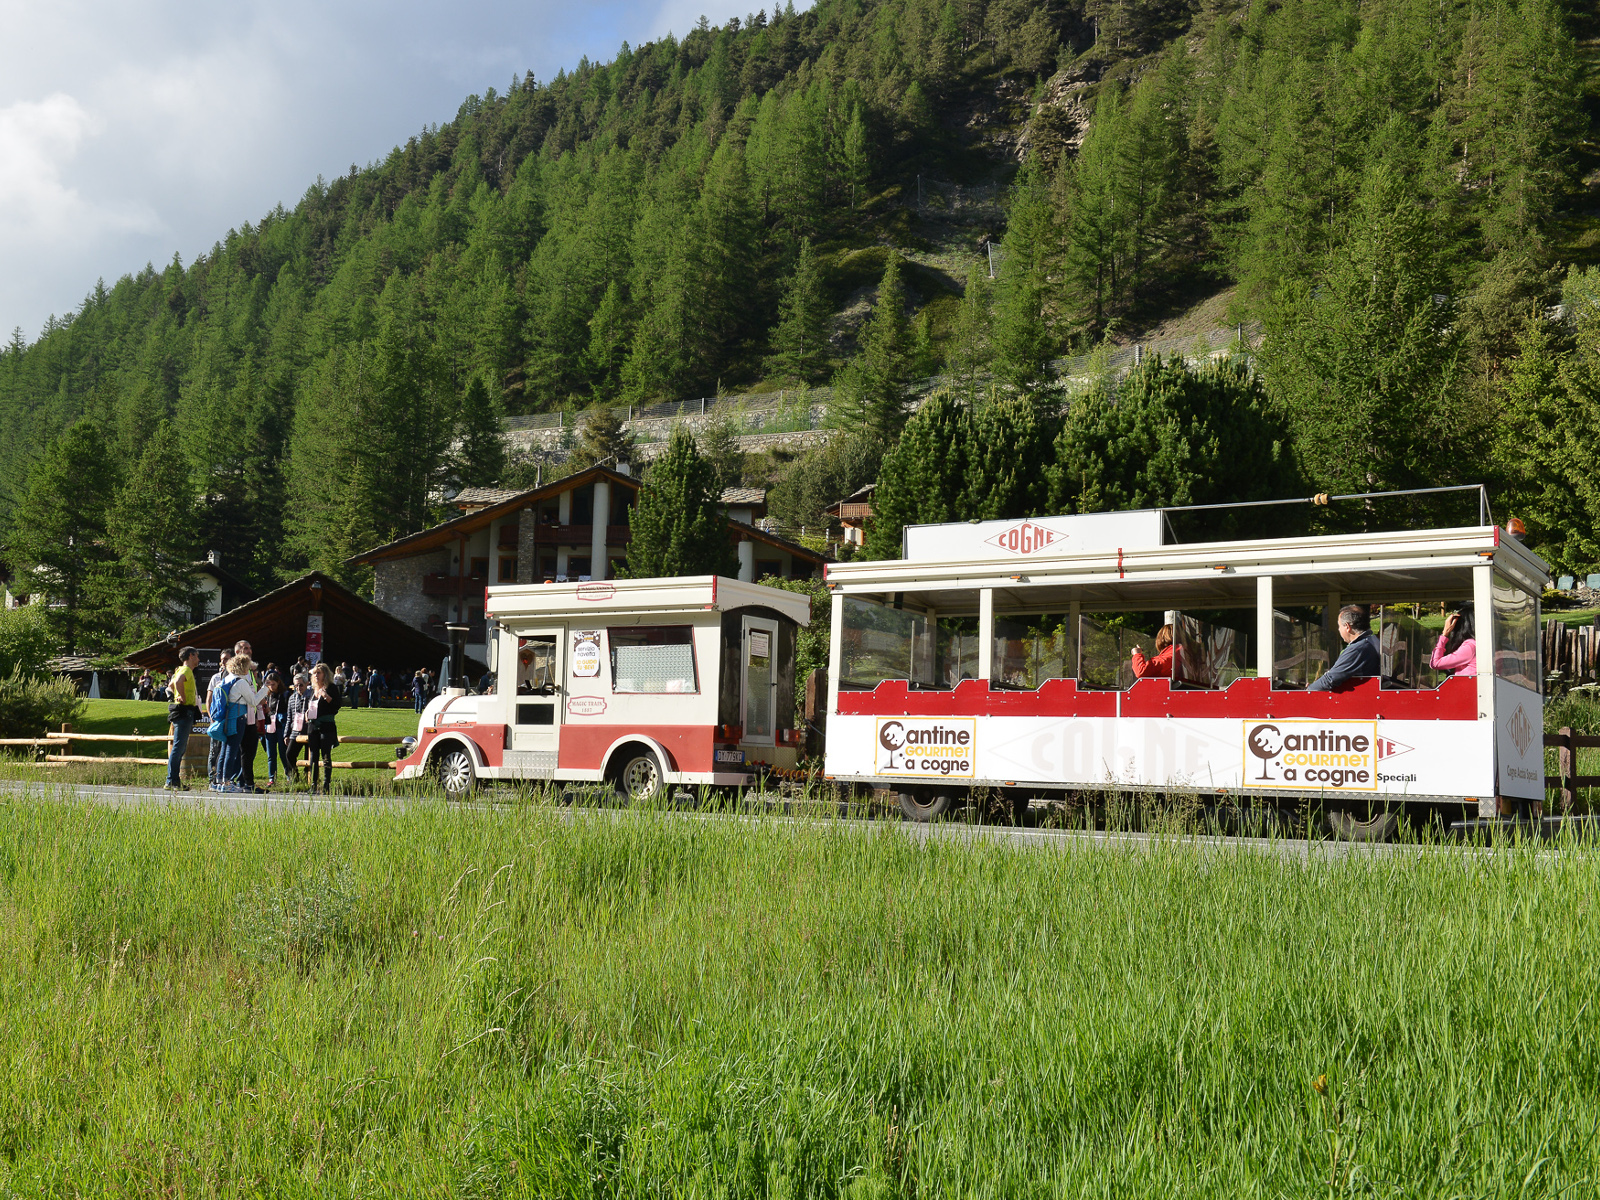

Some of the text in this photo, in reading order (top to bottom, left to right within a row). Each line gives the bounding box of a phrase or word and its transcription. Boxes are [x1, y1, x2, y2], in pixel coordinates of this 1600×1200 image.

[998, 523, 1054, 554] COGNE
[1511, 705, 1531, 756] COGNE
[1031, 716, 1210, 788] COGNE
[921, 759, 970, 776] cogne
[1304, 768, 1370, 788] cogne
[1376, 772, 1417, 783] Speciali
